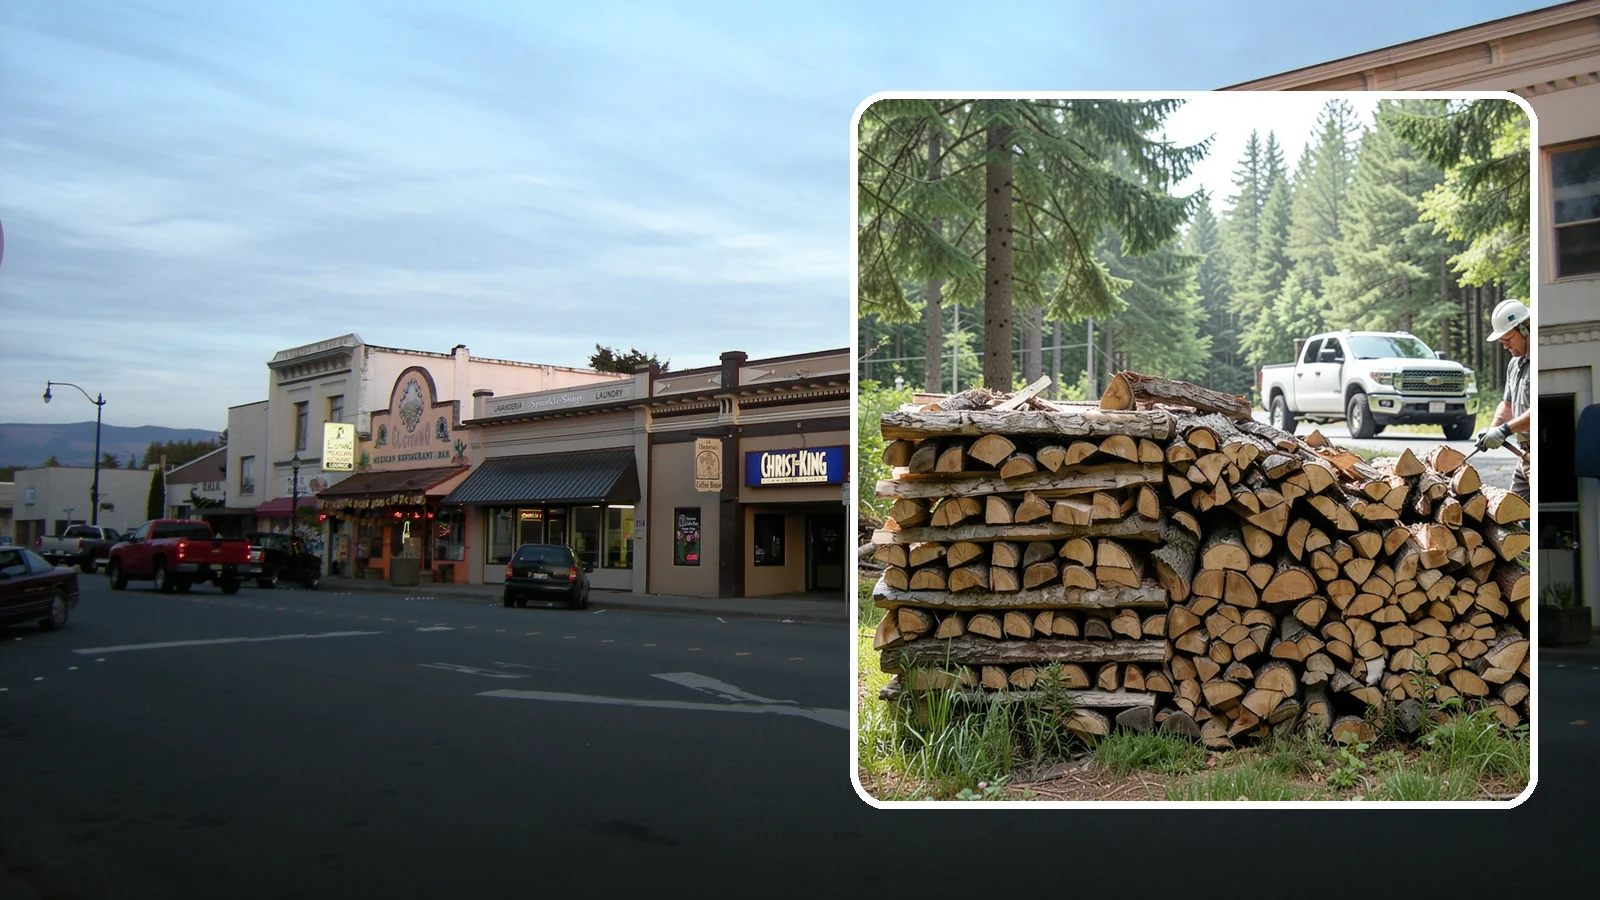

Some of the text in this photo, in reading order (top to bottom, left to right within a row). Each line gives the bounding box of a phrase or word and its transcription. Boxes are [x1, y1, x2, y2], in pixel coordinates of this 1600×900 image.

[531, 394, 582, 408] Sparkle Shop
[595, 389, 623, 400] LAUNDRY
[493, 402, 522, 412] LAVANDERIA
[392, 426, 402, 449] EL
[374, 450, 450, 464] MEXICAN RESTAURANT BAR
[798, 450, 827, 476] KING
